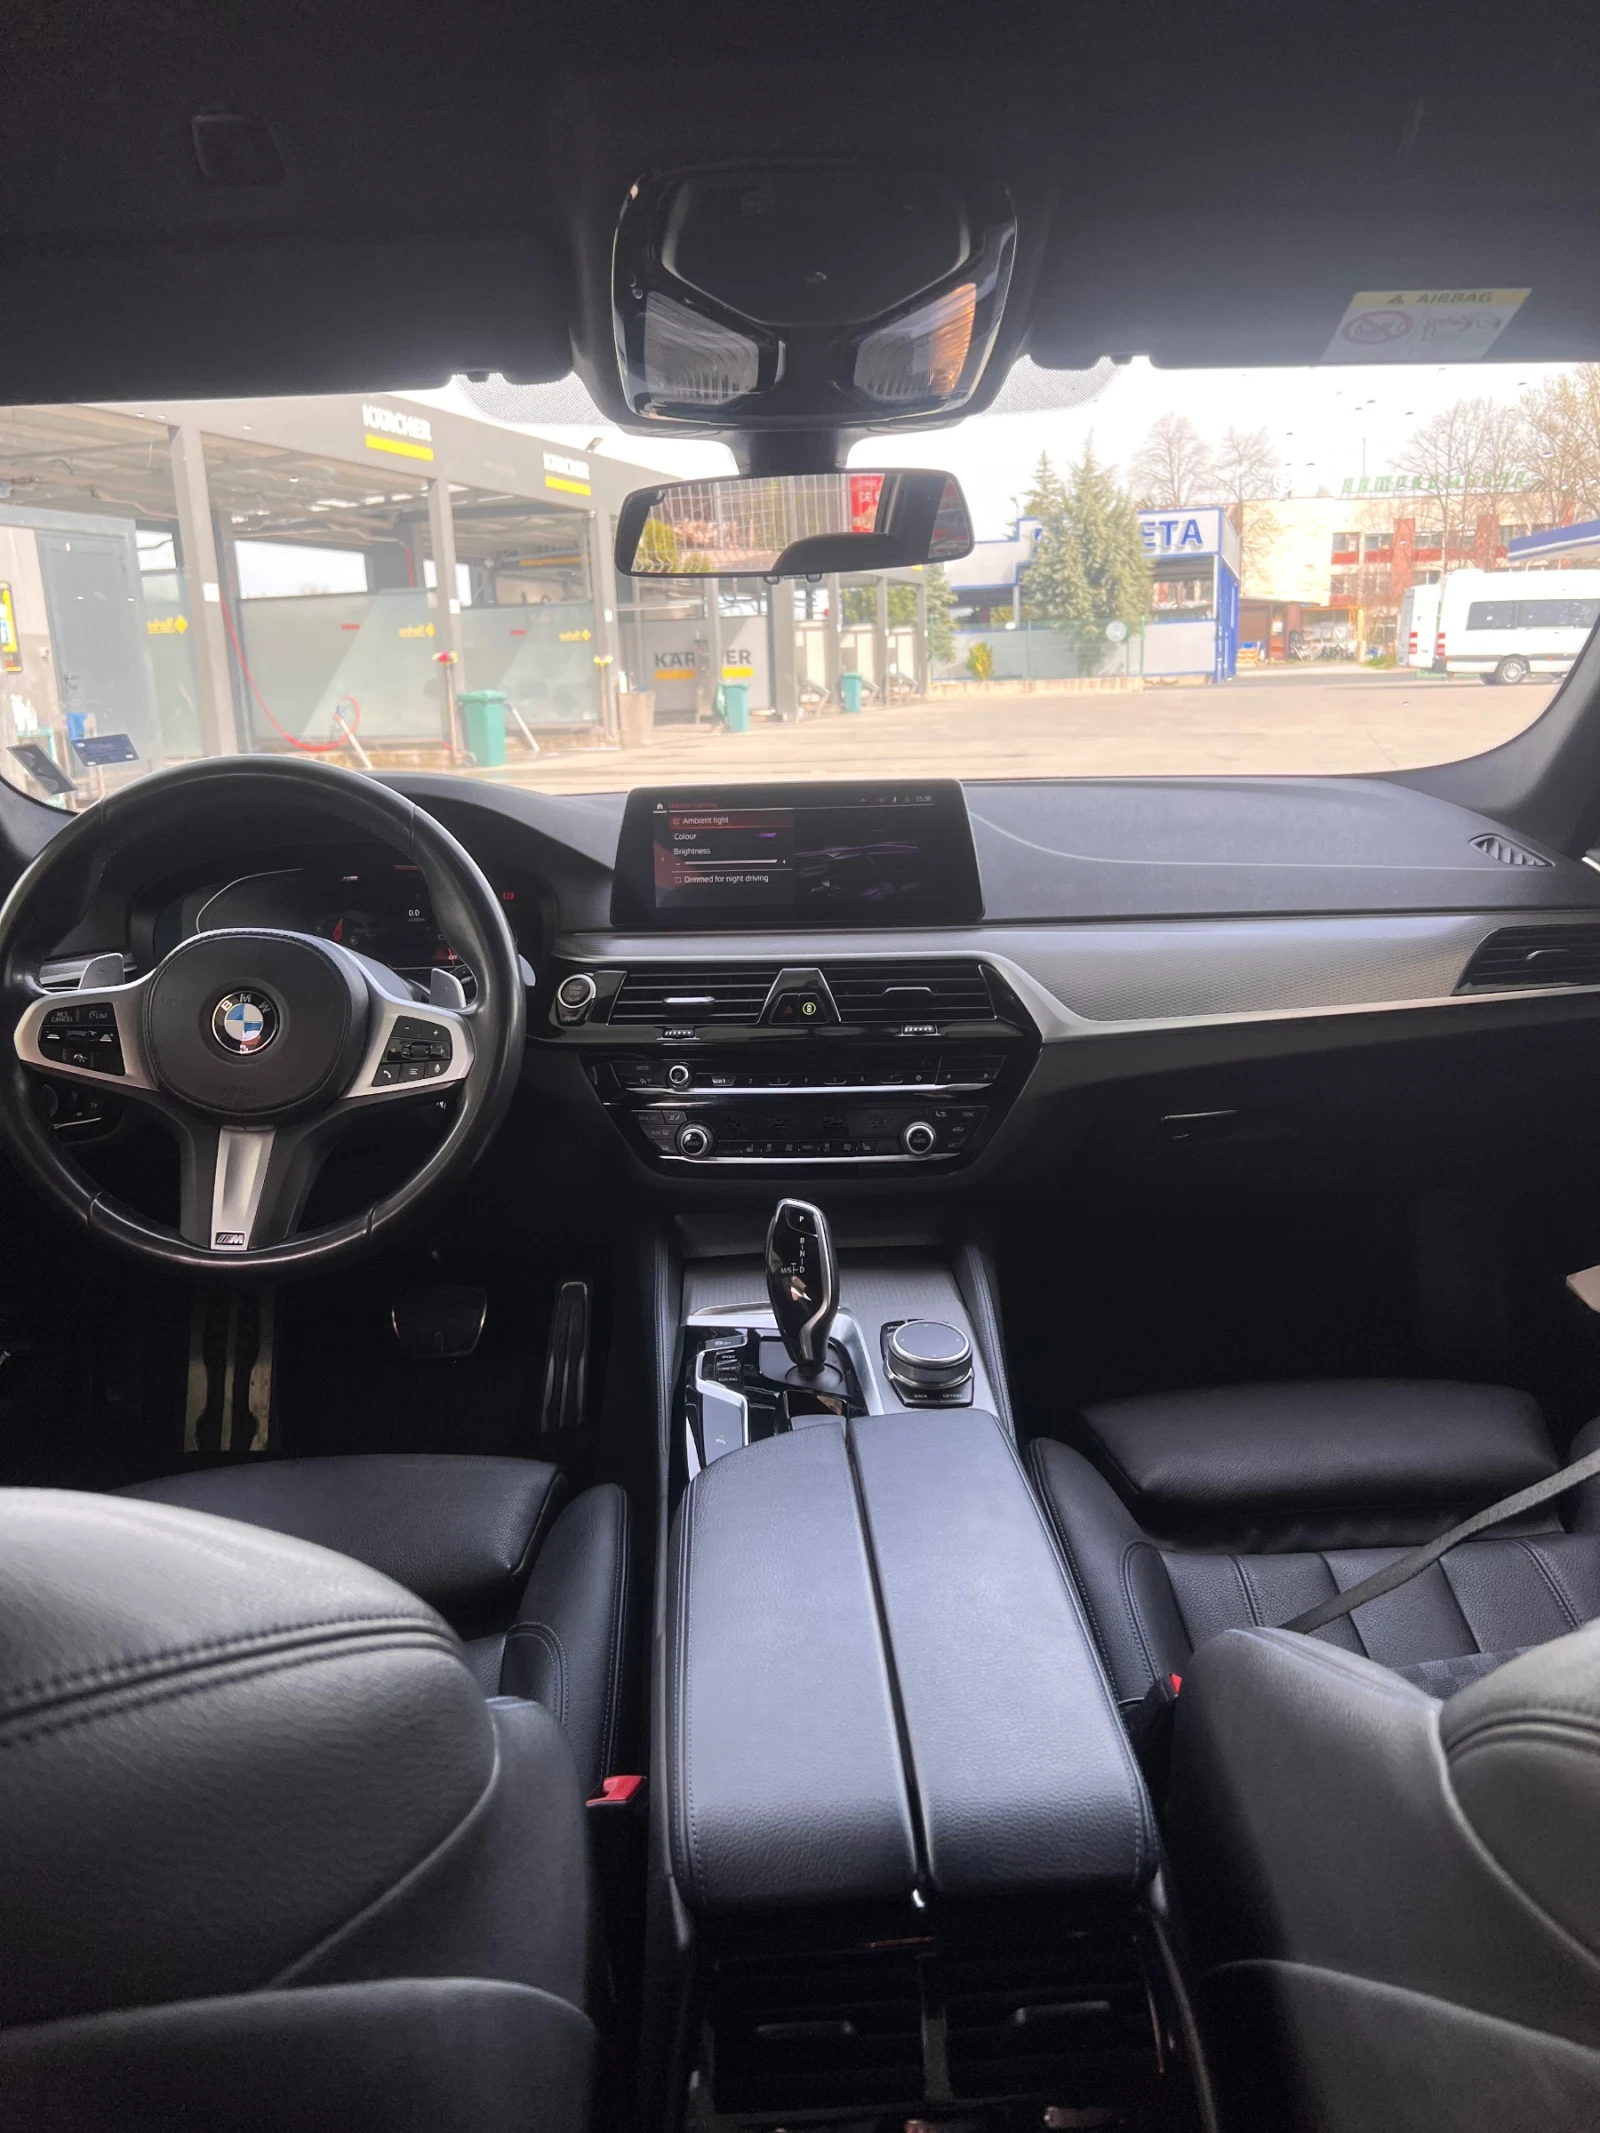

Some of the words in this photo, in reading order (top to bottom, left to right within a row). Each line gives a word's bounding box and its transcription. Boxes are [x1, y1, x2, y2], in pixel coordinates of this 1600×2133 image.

[1415, 291, 1493, 305] AIRBAG
[682, 817, 712, 825] Ambient
[713, 816, 730, 825] light
[673, 832, 697, 841] Colour
[673, 847, 711, 856] Brightness
[684, 875, 714, 883] Dimmed
[715, 875, 725, 883] for
[726, 874, 744, 884] night
[745, 874, 769, 884] driving
[408, 909, 420, 917] 0.0
[221, 993, 272, 1014] BMW
[799, 1265, 805, 1274] D
